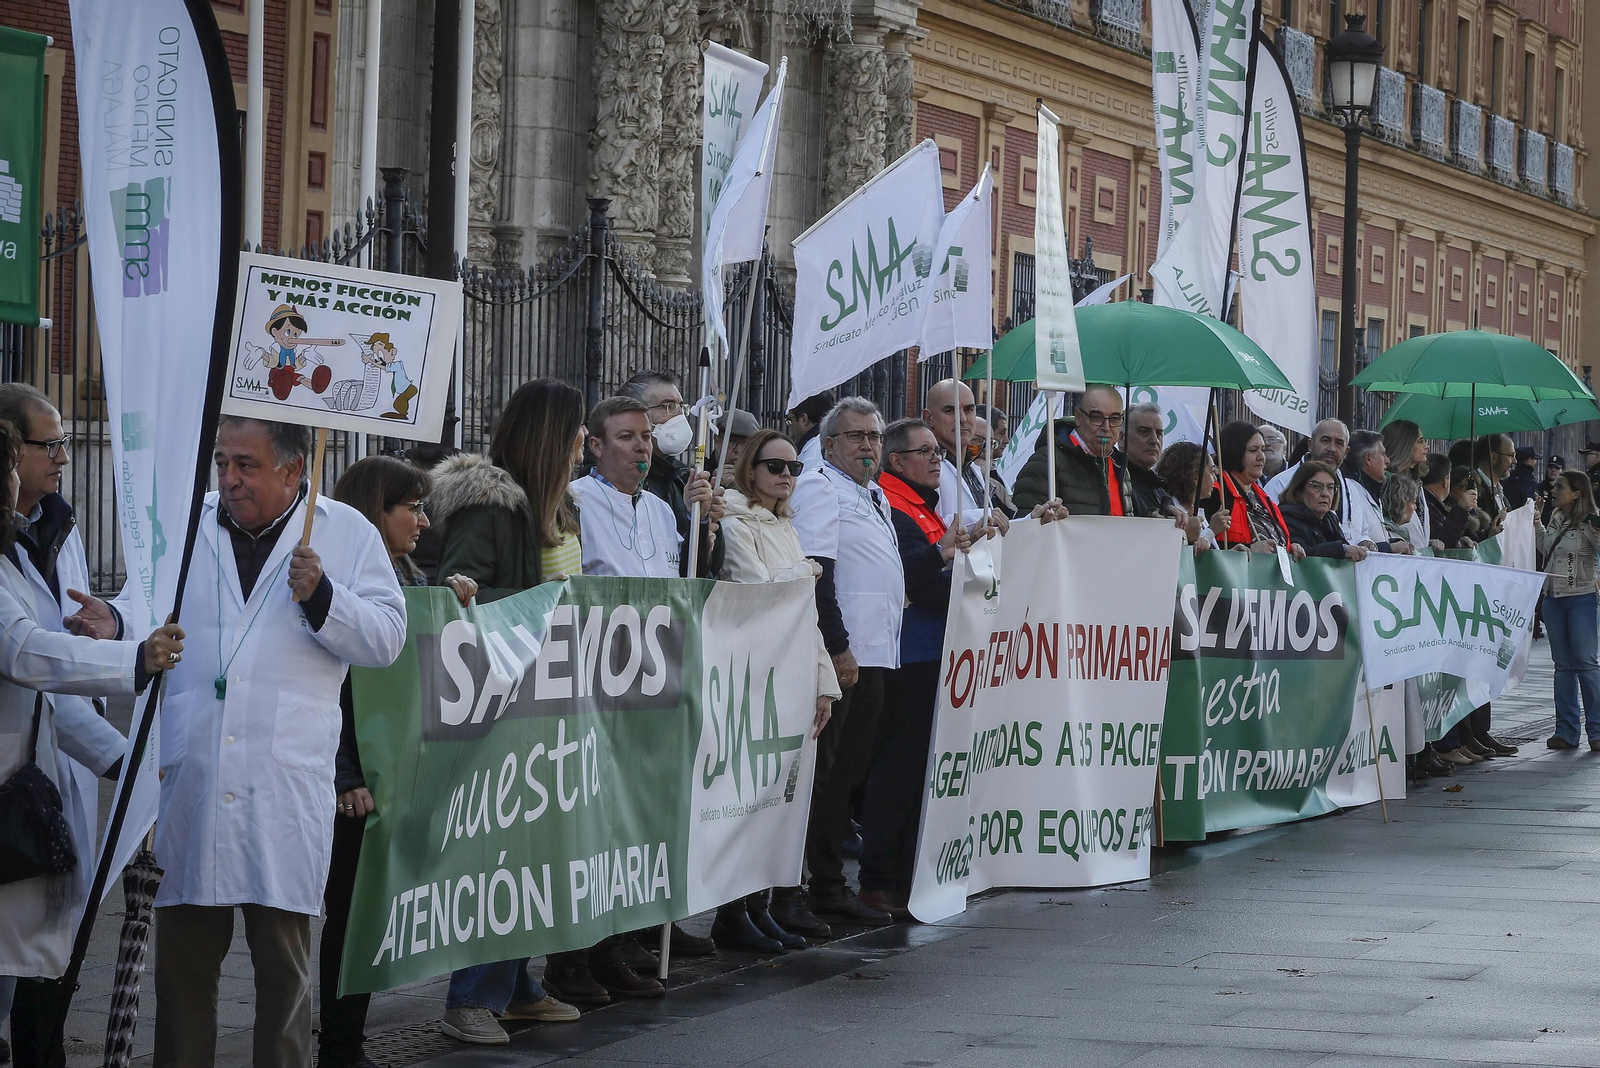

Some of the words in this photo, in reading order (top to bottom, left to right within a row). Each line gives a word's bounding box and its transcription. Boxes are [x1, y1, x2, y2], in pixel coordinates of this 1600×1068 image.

[260, 272, 332, 293] MENOS
[336, 284, 422, 307] FICCIÓN
[820, 216, 918, 332] SMA
[266, 289, 281, 302] Y
[286, 293, 329, 309] MÁS
[332, 300, 411, 322] ACCIÓN
[813, 327, 861, 355] Sindicato
[236, 376, 268, 391] SMA
[1371, 570, 1513, 642] SMA
[1491, 599, 1527, 629] Sevilla
[1384, 644, 1416, 657] Sindicato
[1418, 638, 1447, 649] Médico
[1448, 638, 1473, 651] Andaluz
[1201, 661, 1281, 727] estra
[702, 652, 804, 804] SMA
[1055, 721, 1075, 766] A
[440, 718, 600, 853] nuestra
[978, 809, 1024, 858] POR
[1038, 808, 1127, 862] EQUIPOS
[371, 850, 555, 967] ATENCIÓN
[569, 842, 672, 924] PRIMARIA
